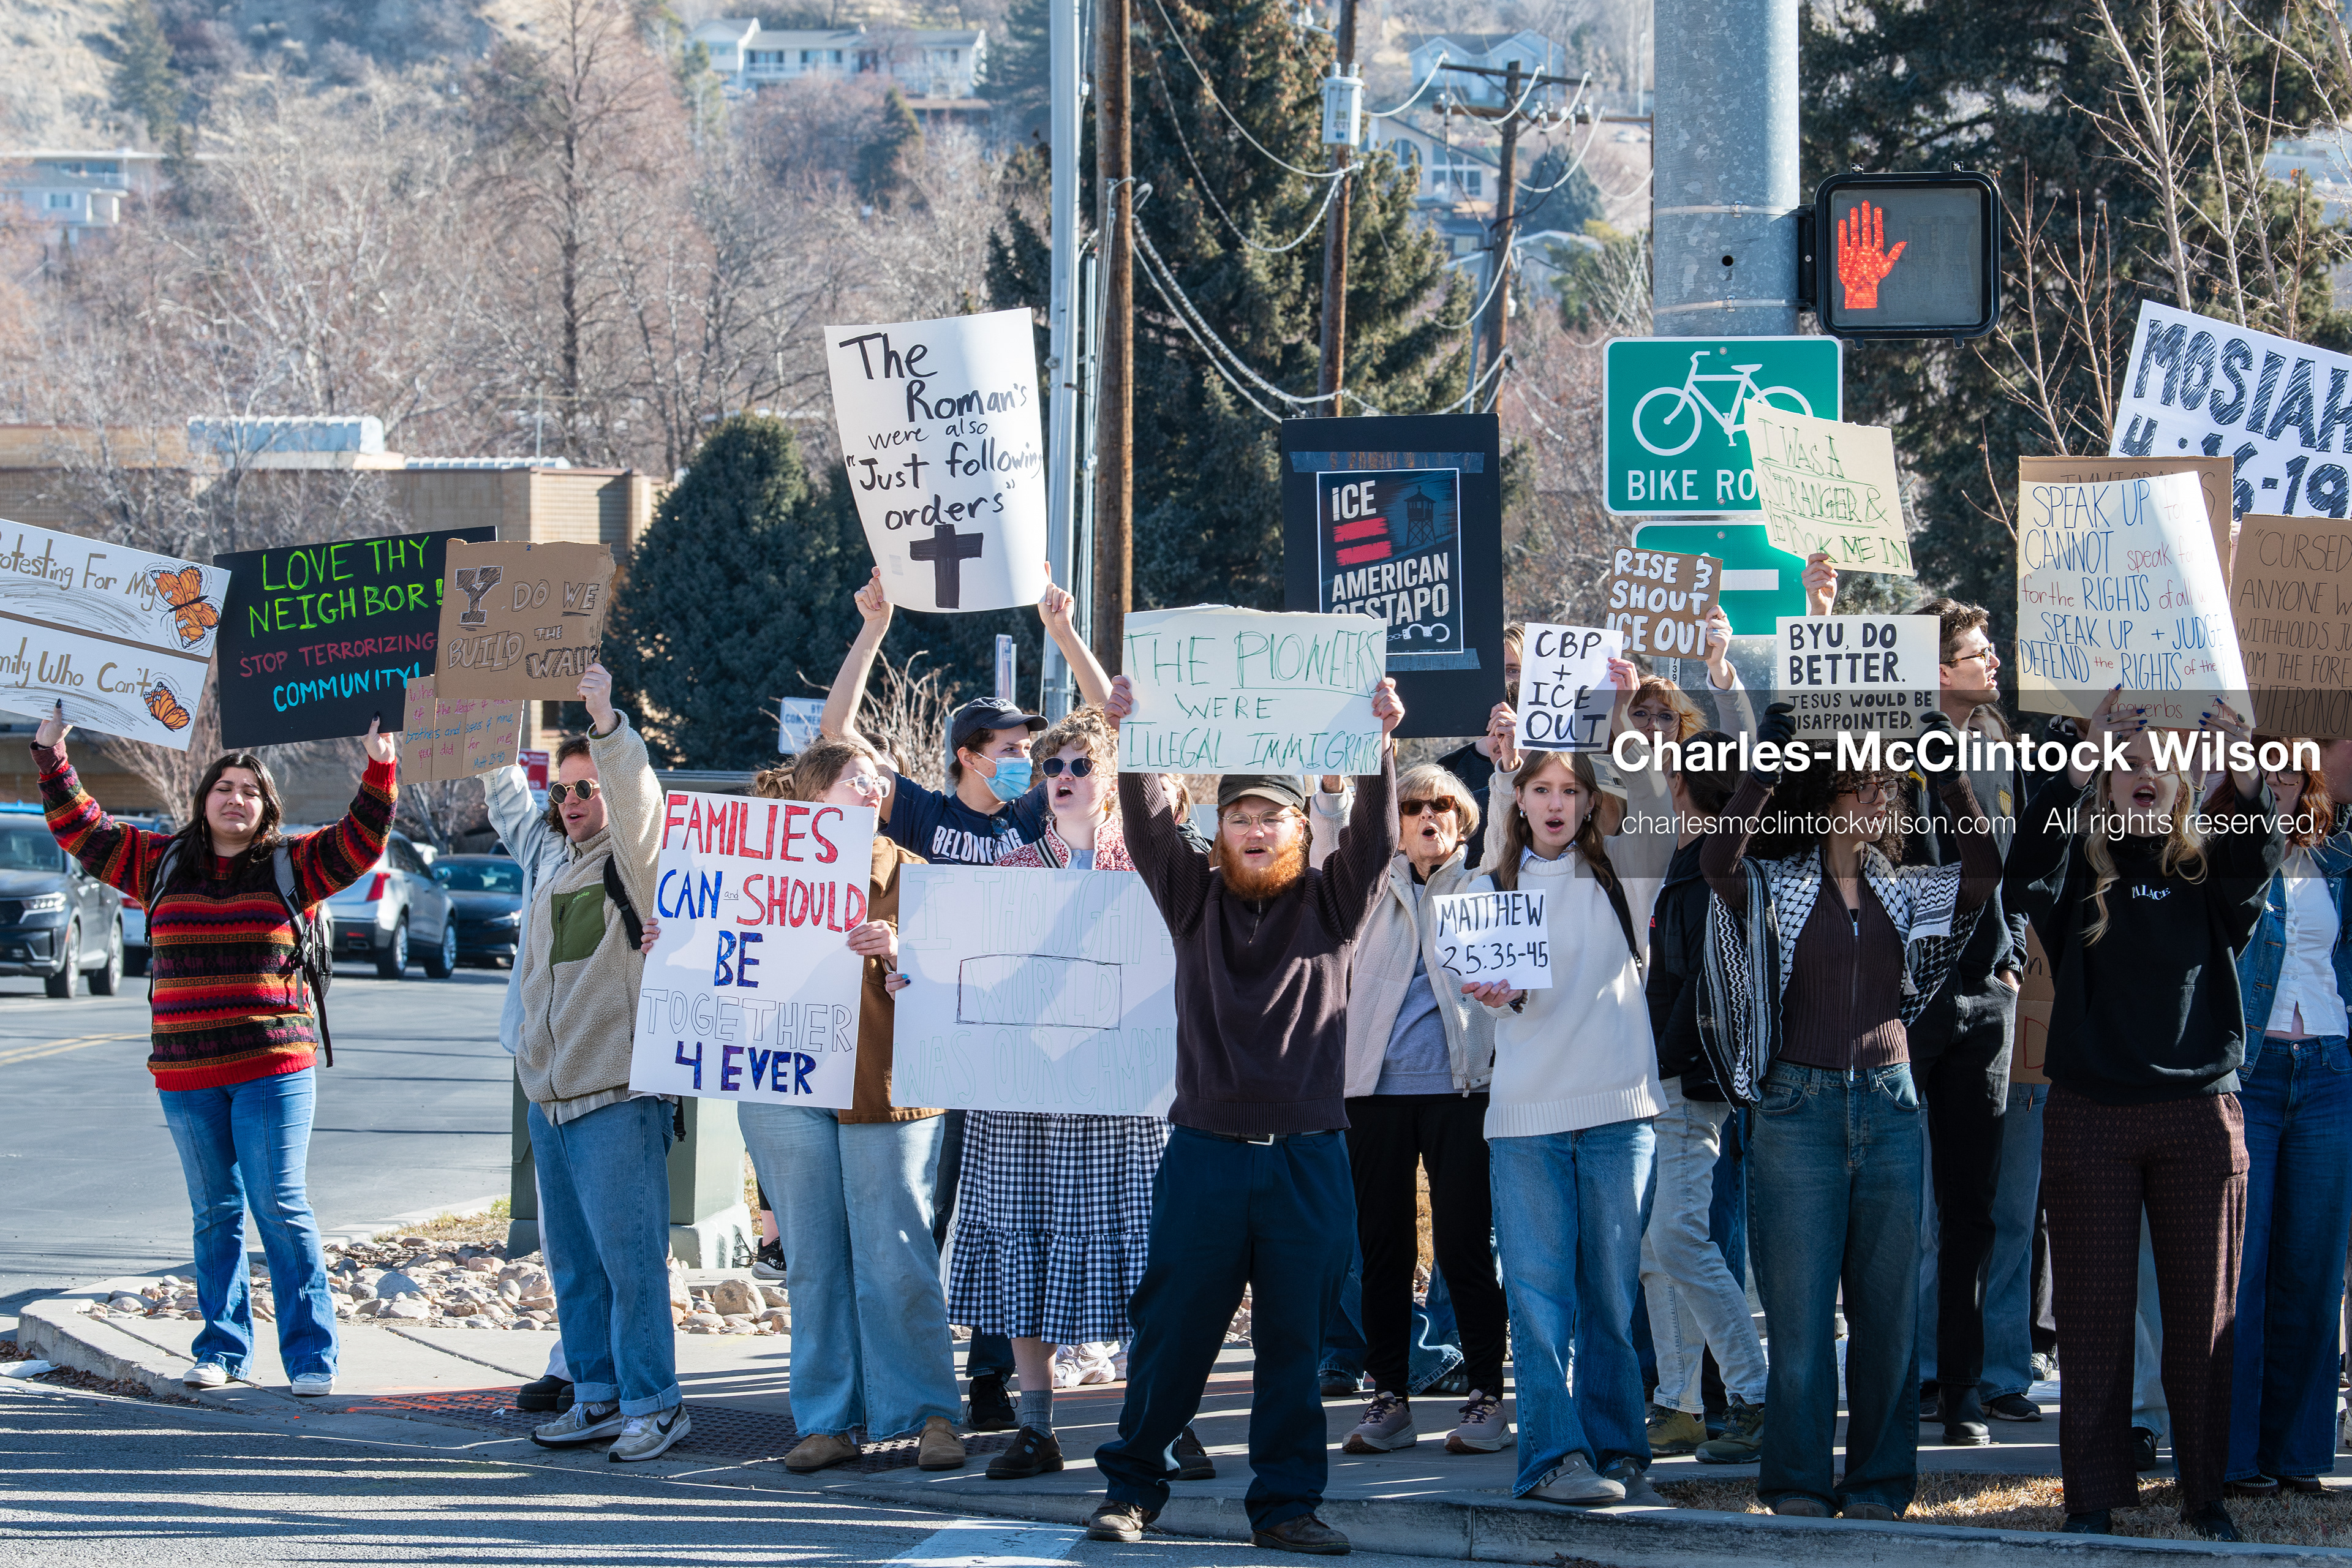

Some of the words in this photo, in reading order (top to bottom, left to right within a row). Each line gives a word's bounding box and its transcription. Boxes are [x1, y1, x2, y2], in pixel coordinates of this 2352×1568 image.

[839, 332, 938, 380] The
[907, 380, 1027, 423] Roman's
[2134, 319, 2352, 453] MOSIAH
[869, 427, 930, 450] were
[945, 418, 988, 437] also
[1758, 418, 1779, 462] I
[1779, 426, 1824, 476] WAS
[1825, 433, 1845, 479] A
[945, 437, 1044, 478] following
[1332, 480, 1376, 521] ICE
[1627, 470, 1698, 501] BIKE
[1762, 464, 1862, 522] STRANGER
[1865, 487, 1891, 526] &
[2033, 484, 2111, 529] SPEAK
[2122, 479, 2150, 526] UP
[0, 531, 74, 590] otesting
[83, 553, 117, 590] For
[125, 571, 156, 612] My
[263, 543, 355, 590] LOVE
[365, 535, 429, 575] THY
[1614, 548, 1680, 583] RISE
[1839, 535, 1875, 564] ME
[1879, 537, 1909, 568] IN
[2025, 529, 2114, 574] CANNOT
[2127, 541, 2173, 573] speak
[455, 565, 503, 624] Y
[511, 579, 550, 612] DO
[563, 581, 600, 609] WE
[1332, 552, 1449, 602] AMERICAN
[1610, 579, 1709, 615] SHOUT
[2021, 574, 2046, 605] for
[2049, 581, 2075, 607] the
[2082, 574, 2150, 612] RIGHTS
[2159, 579, 2174, 609] of
[2173, 577, 2193, 607] all
[2239, 579, 2328, 614] ANYONE
[249, 578, 443, 638] NEIGHBOR!
[448, 630, 524, 672] BUILD
[534, 625, 562, 641] THE
[1536, 630, 1602, 659] CBP
[1654, 617, 1708, 656] OUT
[1789, 622, 1849, 650] BYU,
[1862, 622, 1897, 649] DO
[2041, 611, 2101, 648] SPEAK
[2108, 619, 2133, 650] UP
[2151, 625, 2165, 641] +
[2236, 617, 2329, 650] WITHHOLDS
[38, 651, 84, 687] Who
[97, 662, 152, 697] Can't
[240, 651, 288, 677] STOP
[298, 632, 437, 666] TERRORIZING
[1123, 631, 1216, 686] THE
[1234, 630, 1383, 693] PIONEERS
[1552, 664, 1572, 681] +
[1789, 651, 1905, 685] BETTER.
[2019, 639, 2090, 683] DEFEND
[2094, 655, 2114, 669] the
[2120, 652, 2182, 691] RIGHTS
[2184, 658, 2196, 676] of
[2199, 655, 2217, 673] the
[2240, 650, 2266, 677] OM
[2277, 652, 2303, 680] THE
[2311, 655, 2352, 687] FORE
[273, 662, 420, 712] COMMUNITY!
[1175, 694, 1281, 719] WERE
[1528, 682, 1591, 709] ICE
[1789, 693, 1841, 709] JESUS
[1850, 693, 1906, 707] WOULD
[1915, 691, 1932, 707] BE
[413, 706, 425, 729] of
[436, 701, 451, 719] the
[454, 699, 477, 714] least
[445, 721, 461, 736] and
[1526, 710, 1607, 744] OUT
[2248, 683, 2352, 736] UTERONO
[418, 747, 432, 768] you
[440, 742, 453, 755] did
[468, 737, 480, 756] for
[1120, 722, 1232, 768] ILLEGAL
[1245, 730, 1382, 774] IMMIGRANTS
[662, 794, 843, 864] FAMILIES
[657, 869, 723, 919] CAN
[724, 889, 739, 900] and
[736, 874, 867, 933] SHOULD
[2132, 884, 2171, 900] PALACE
[906, 872, 955, 950] I
[974, 871, 1147, 964] THOUGHT
[1439, 893, 1544, 937] MATTHEW
[714, 930, 763, 988] BE
[1441, 941, 1548, 976] 25:35-45
[969, 956, 1118, 1028] WORLD
[642, 988, 853, 1052] TOGETHER
[675, 1040, 703, 1090] 4
[720, 1045, 816, 1096] EVER
[894, 1031, 976, 1105] WAS
[994, 1029, 1061, 1104] OUR
[1066, 1028, 1176, 1112] CAMPU
